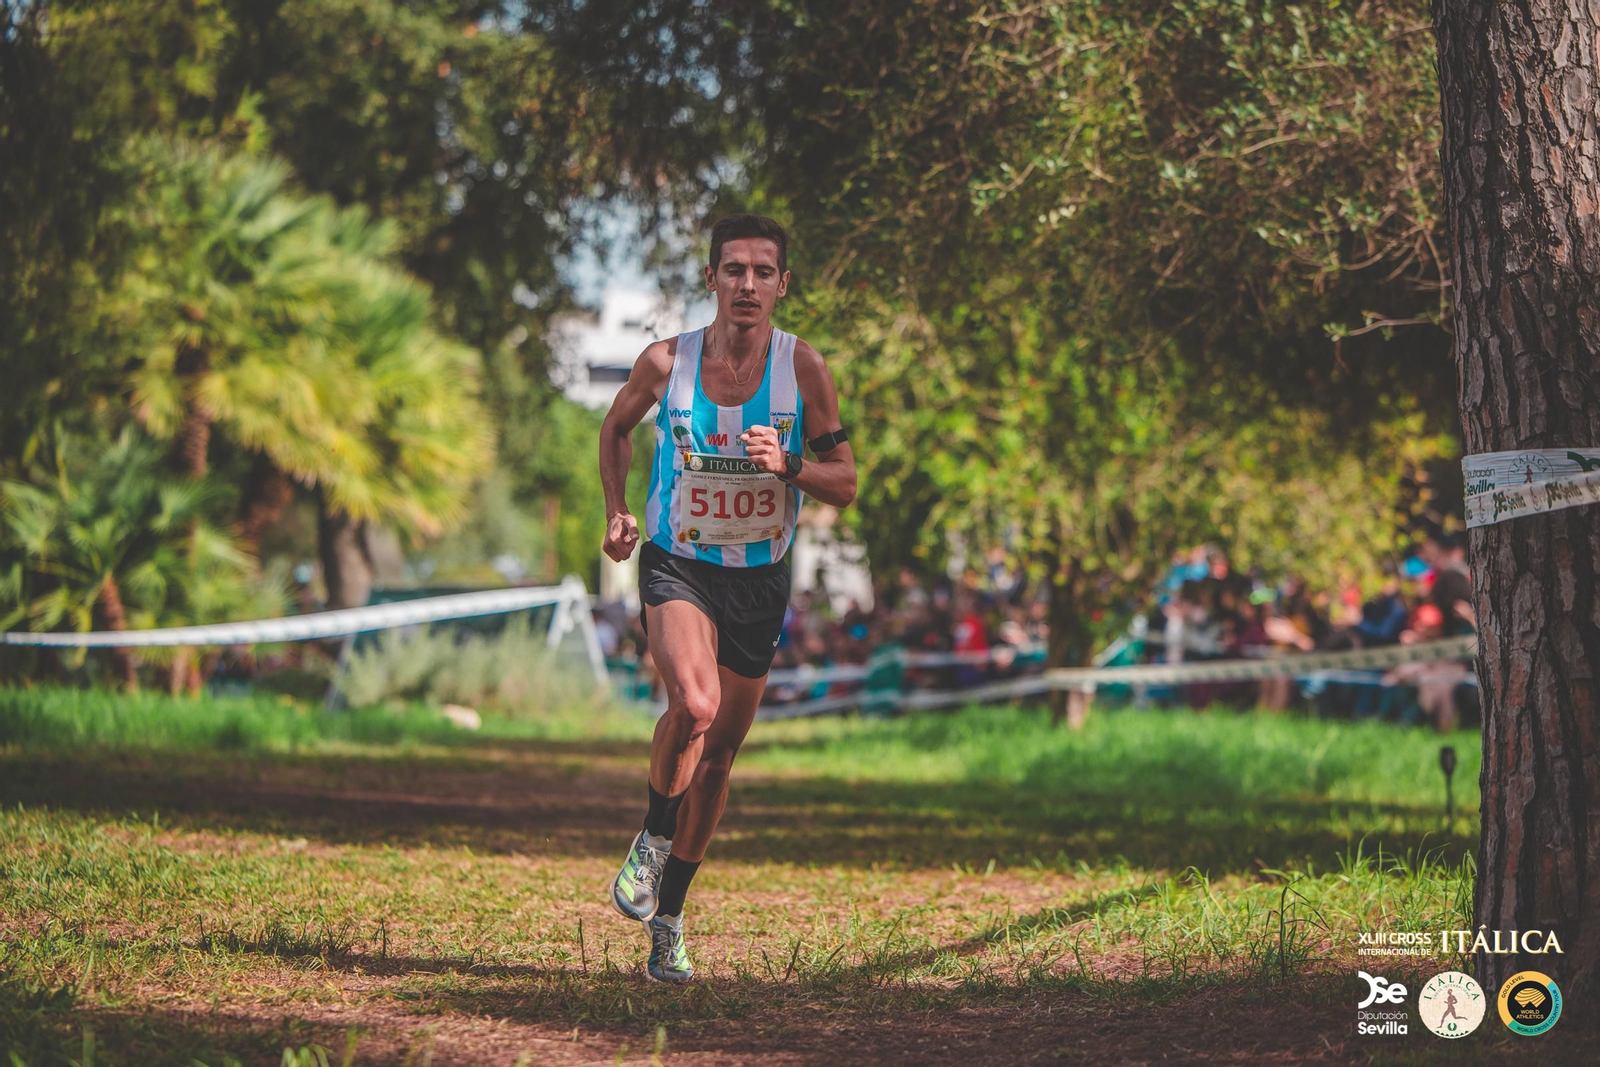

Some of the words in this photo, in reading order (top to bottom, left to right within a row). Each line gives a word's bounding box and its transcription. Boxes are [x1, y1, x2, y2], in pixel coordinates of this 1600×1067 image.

[669, 408, 692, 418] vive
[709, 459, 757, 472] ITÁLICA
[1467, 467, 1496, 479] putación
[690, 488, 776, 519] 5103
